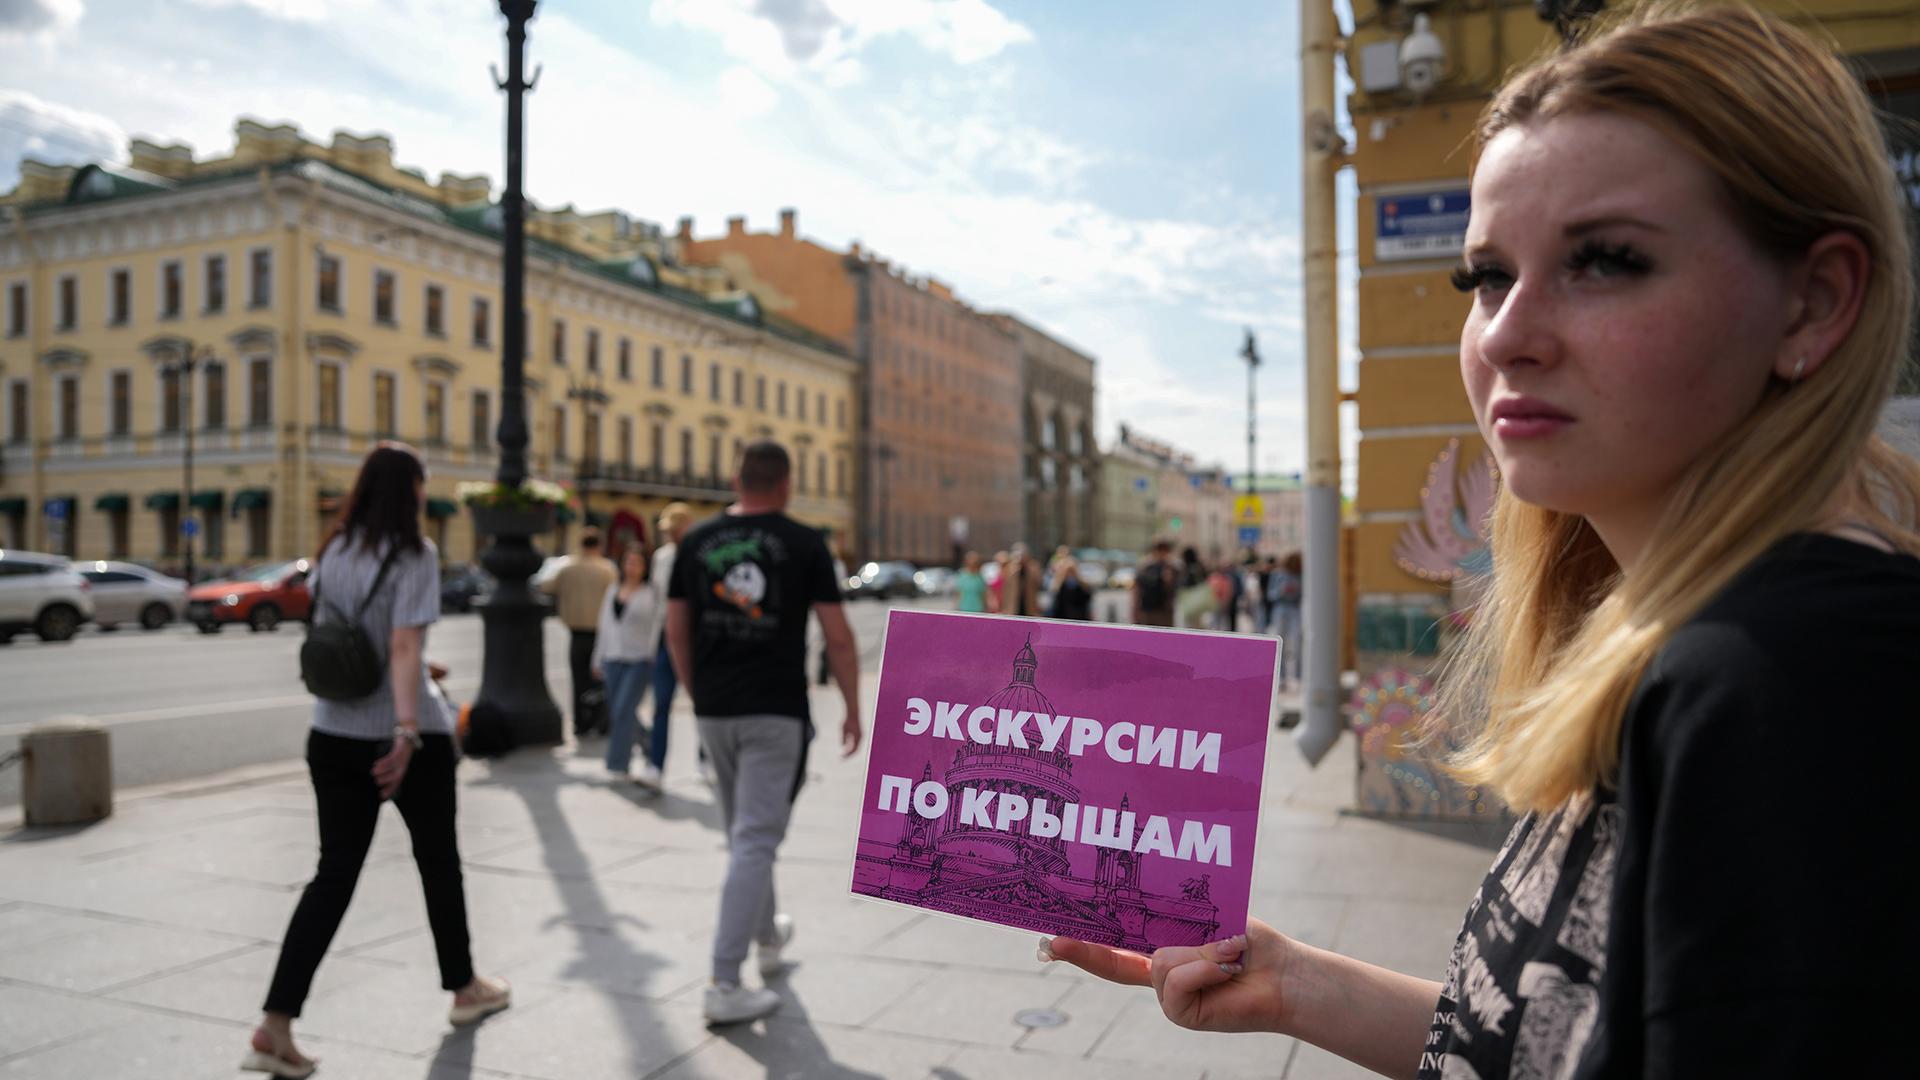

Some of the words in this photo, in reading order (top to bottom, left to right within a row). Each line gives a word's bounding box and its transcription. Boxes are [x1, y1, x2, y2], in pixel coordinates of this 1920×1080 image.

[903, 697, 1222, 773] ЭКСКУРСИИ
[878, 774, 949, 819] ПО
[959, 786, 1232, 867] КРЫШАМ
